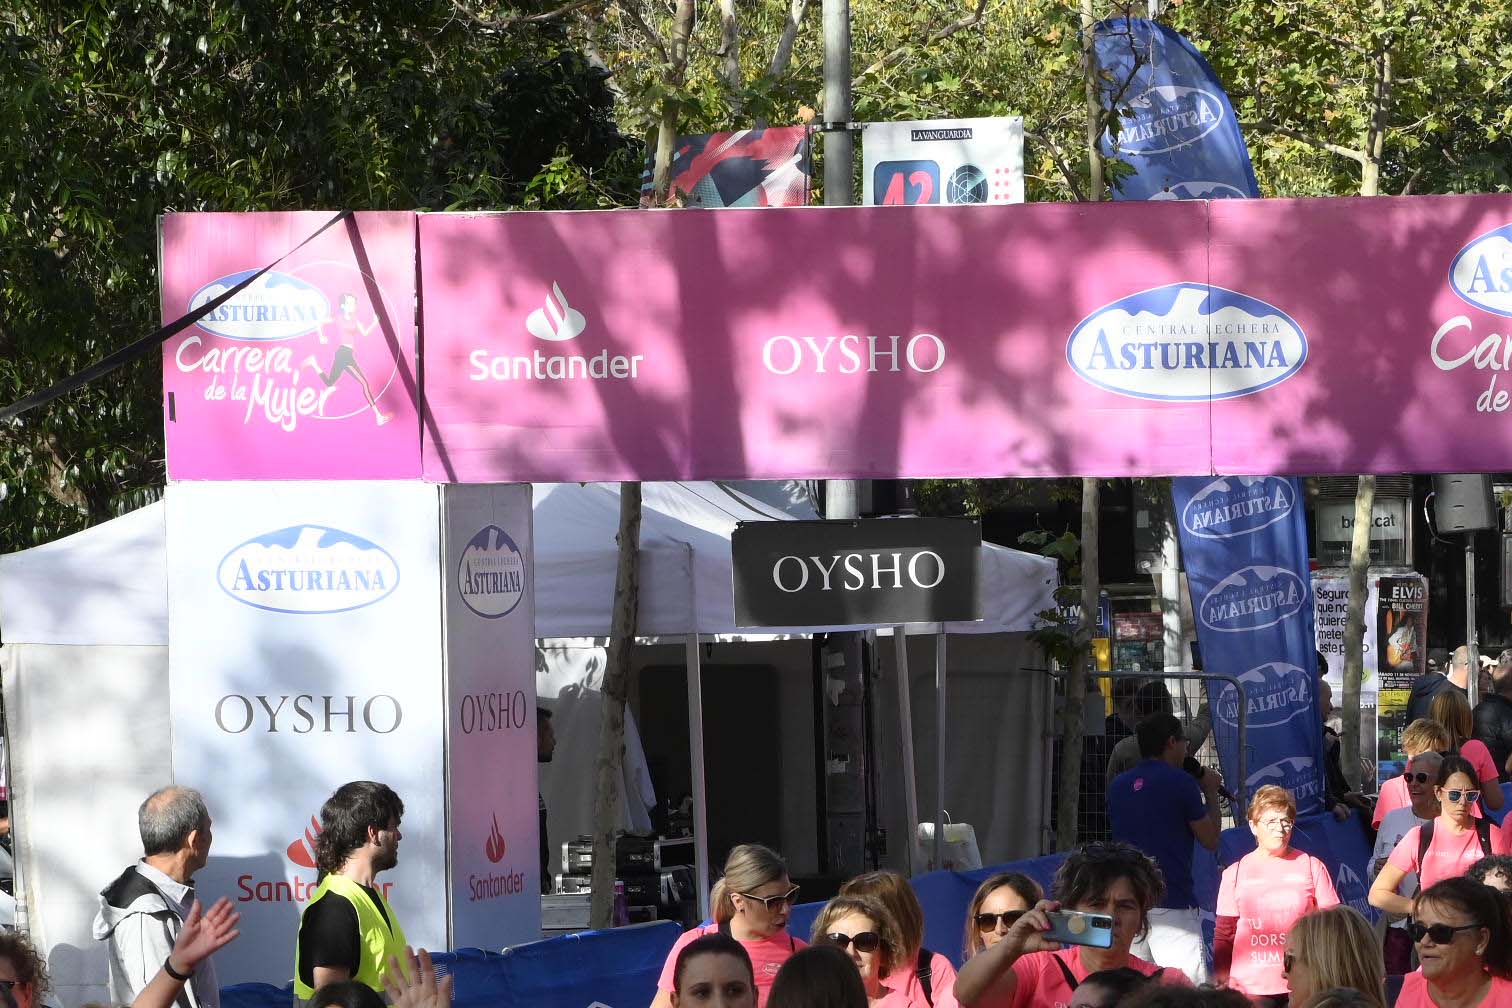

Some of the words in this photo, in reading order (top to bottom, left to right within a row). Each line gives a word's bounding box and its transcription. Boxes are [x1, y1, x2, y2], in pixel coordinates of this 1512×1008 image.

[199, 295, 321, 322] ASTURIANA
[1122, 322, 1197, 336] CENTRAL
[1203, 321, 1280, 335] LECHERA
[175, 336, 294, 373] Carrera
[469, 349, 644, 381] Santander
[762, 333, 946, 374] OYSHO
[1085, 333, 1289, 371] ASTURIANA
[204, 375, 227, 401] de
[231, 374, 247, 401] la
[244, 371, 337, 432] Mujer
[1476, 388, 1508, 413] de
[231, 557, 386, 593] ASTURIANA
[463, 560, 522, 595] ASTURIANA
[772, 551, 945, 592] OYSHO
[1317, 603, 1333, 614] que
[1392, 586, 1423, 599] ELVIS
[1319, 643, 1338, 653] este
[213, 694, 403, 734] OYSHO
[460, 690, 527, 734] OYSHO
[468, 871, 525, 901] Santander
[1250, 933, 1287, 946] DORS
[1250, 951, 1284, 963] SUM
